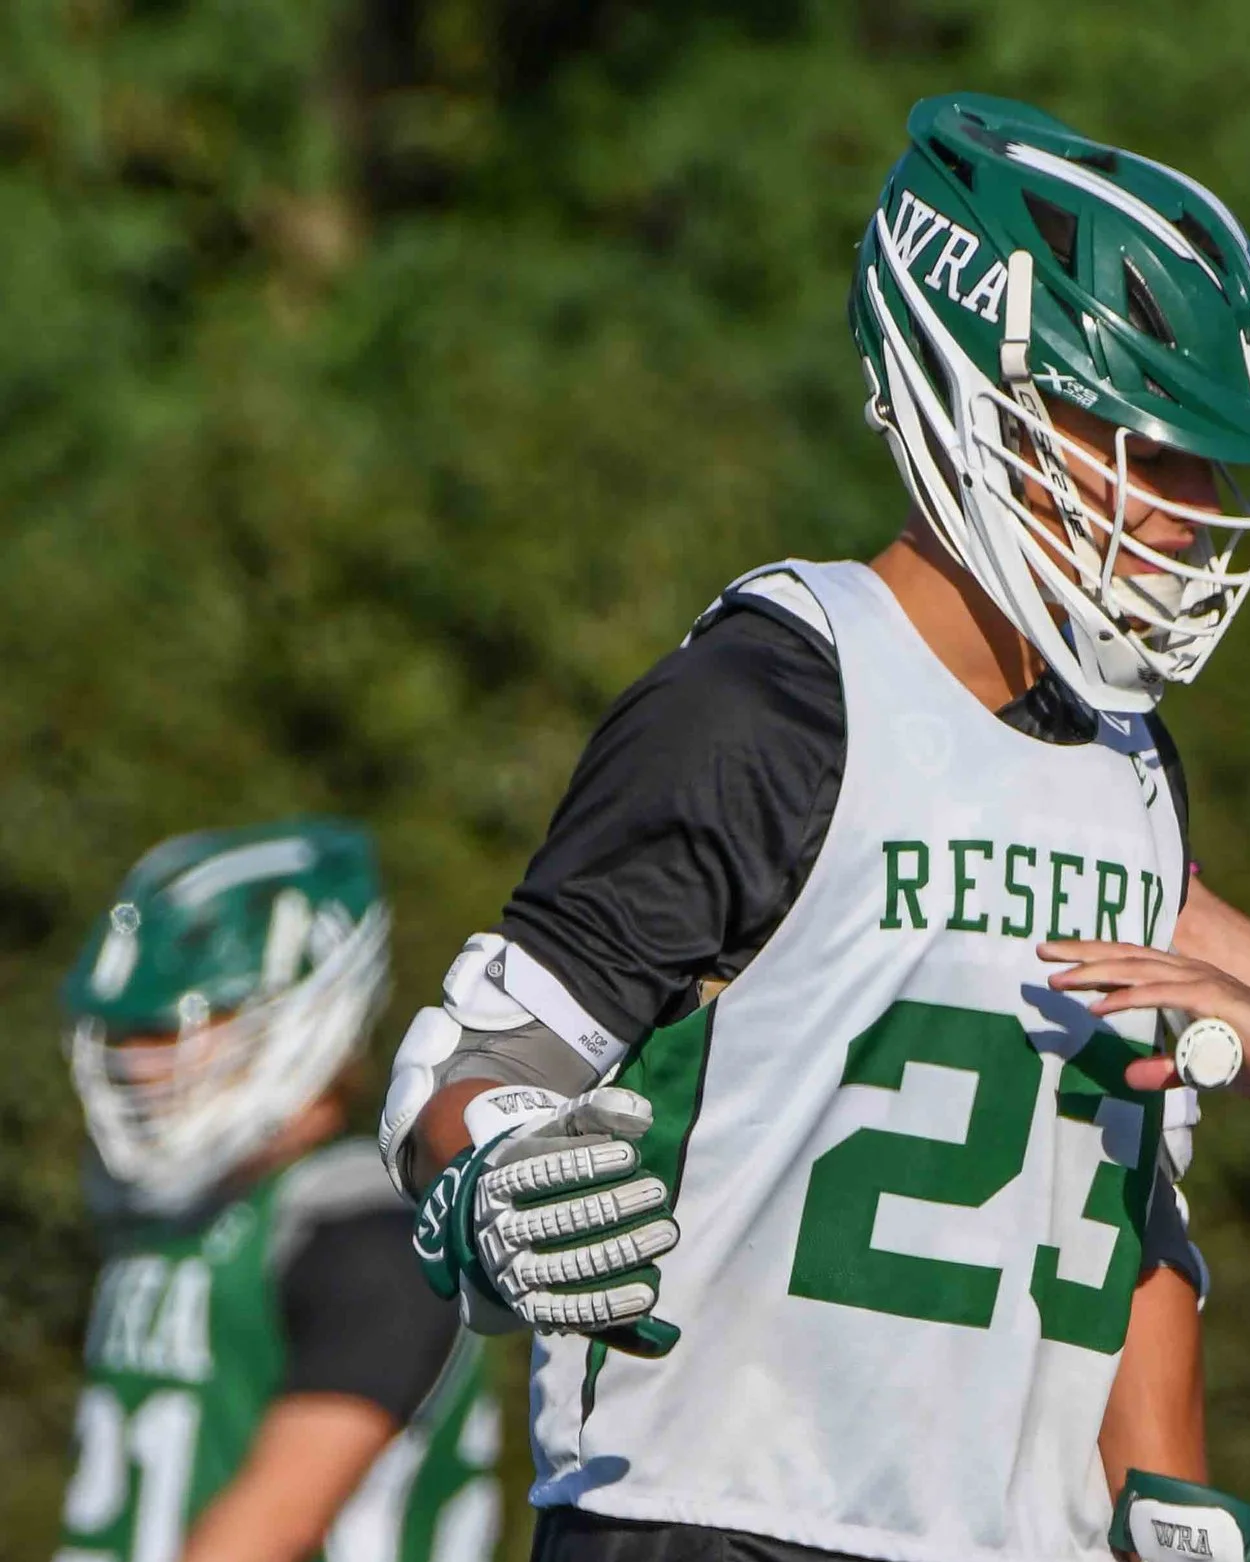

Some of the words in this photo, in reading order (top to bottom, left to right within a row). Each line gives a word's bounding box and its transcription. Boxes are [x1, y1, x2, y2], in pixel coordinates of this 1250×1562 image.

[891, 189, 1008, 323] WRA
[578, 1034, 605, 1058] RIGHT
[590, 1030, 608, 1047] TOP
[787, 999, 1166, 1356] 23
[1151, 1519, 1213, 1558] WRA
